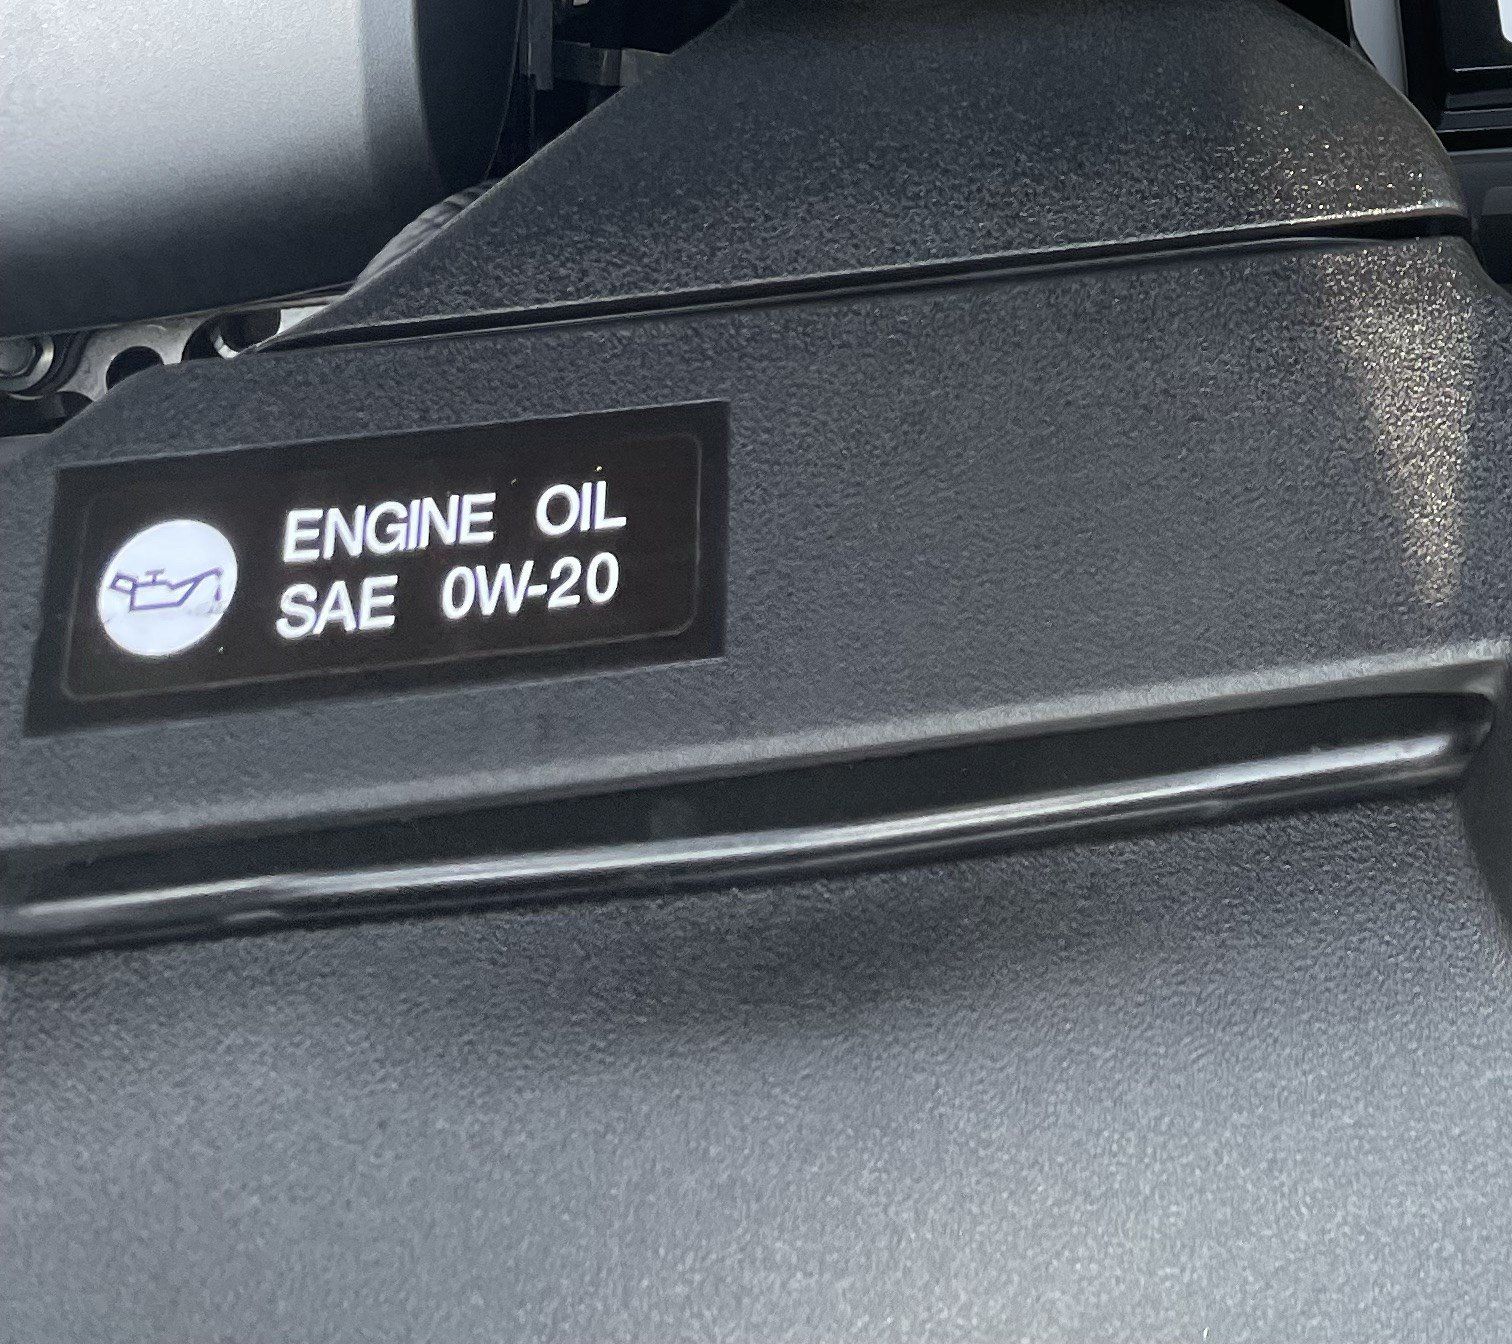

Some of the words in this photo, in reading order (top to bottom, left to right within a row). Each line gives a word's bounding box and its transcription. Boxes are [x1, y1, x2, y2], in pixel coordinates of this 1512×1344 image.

[281, 489, 499, 566] ENGINE
[534, 479, 629, 539] OIL
[273, 572, 400, 643] SAE
[440, 549, 622, 624] 0W-20
